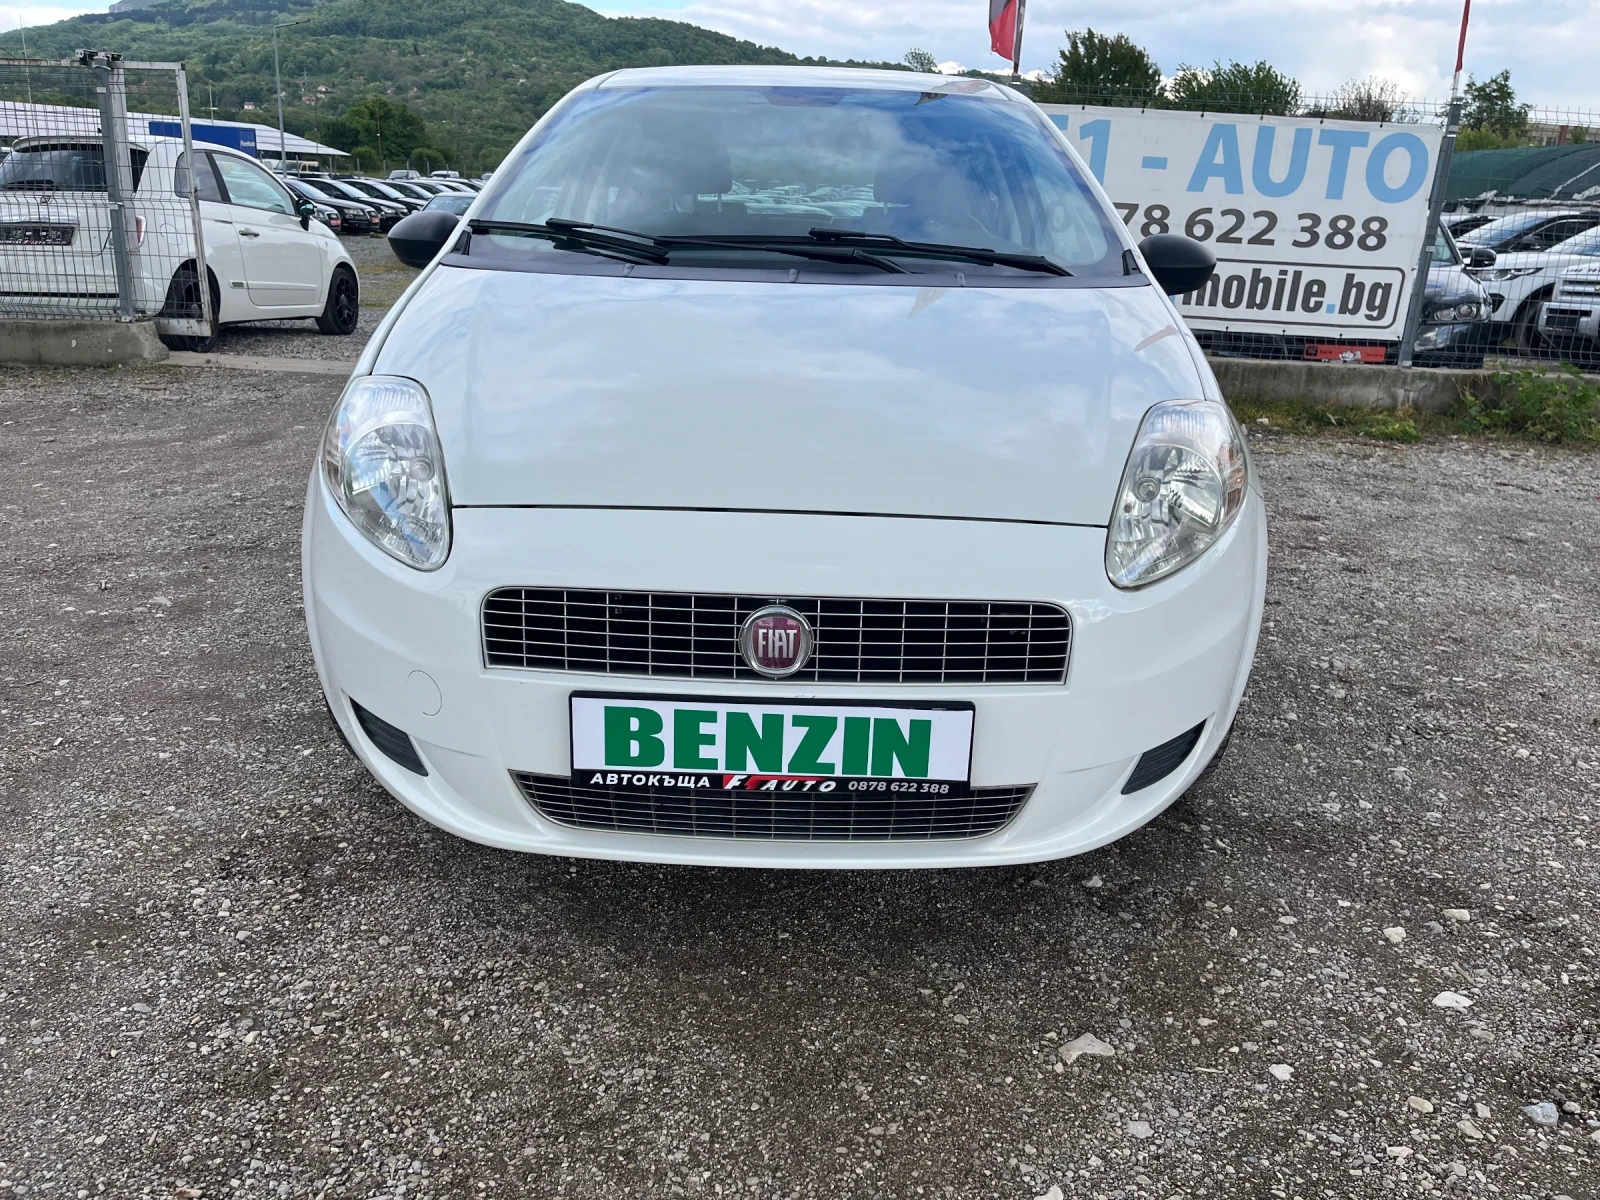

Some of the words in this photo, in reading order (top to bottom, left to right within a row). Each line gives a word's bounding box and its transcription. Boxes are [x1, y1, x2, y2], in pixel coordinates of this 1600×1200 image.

[1048, 114, 1112, 187] 1
[1186, 122, 1429, 203] AUTO
[1184, 207, 1279, 246] 622
[1291, 212, 1389, 252] 388
[758, 628, 798, 659] FIAT
[604, 705, 932, 778] BENZIN
[589, 772, 711, 789] АВТОКЪЩА
[760, 779, 837, 793] AUTO
[848, 781, 887, 792] 0878
[890, 782, 918, 793] 622
[919, 783, 950, 794] 388
